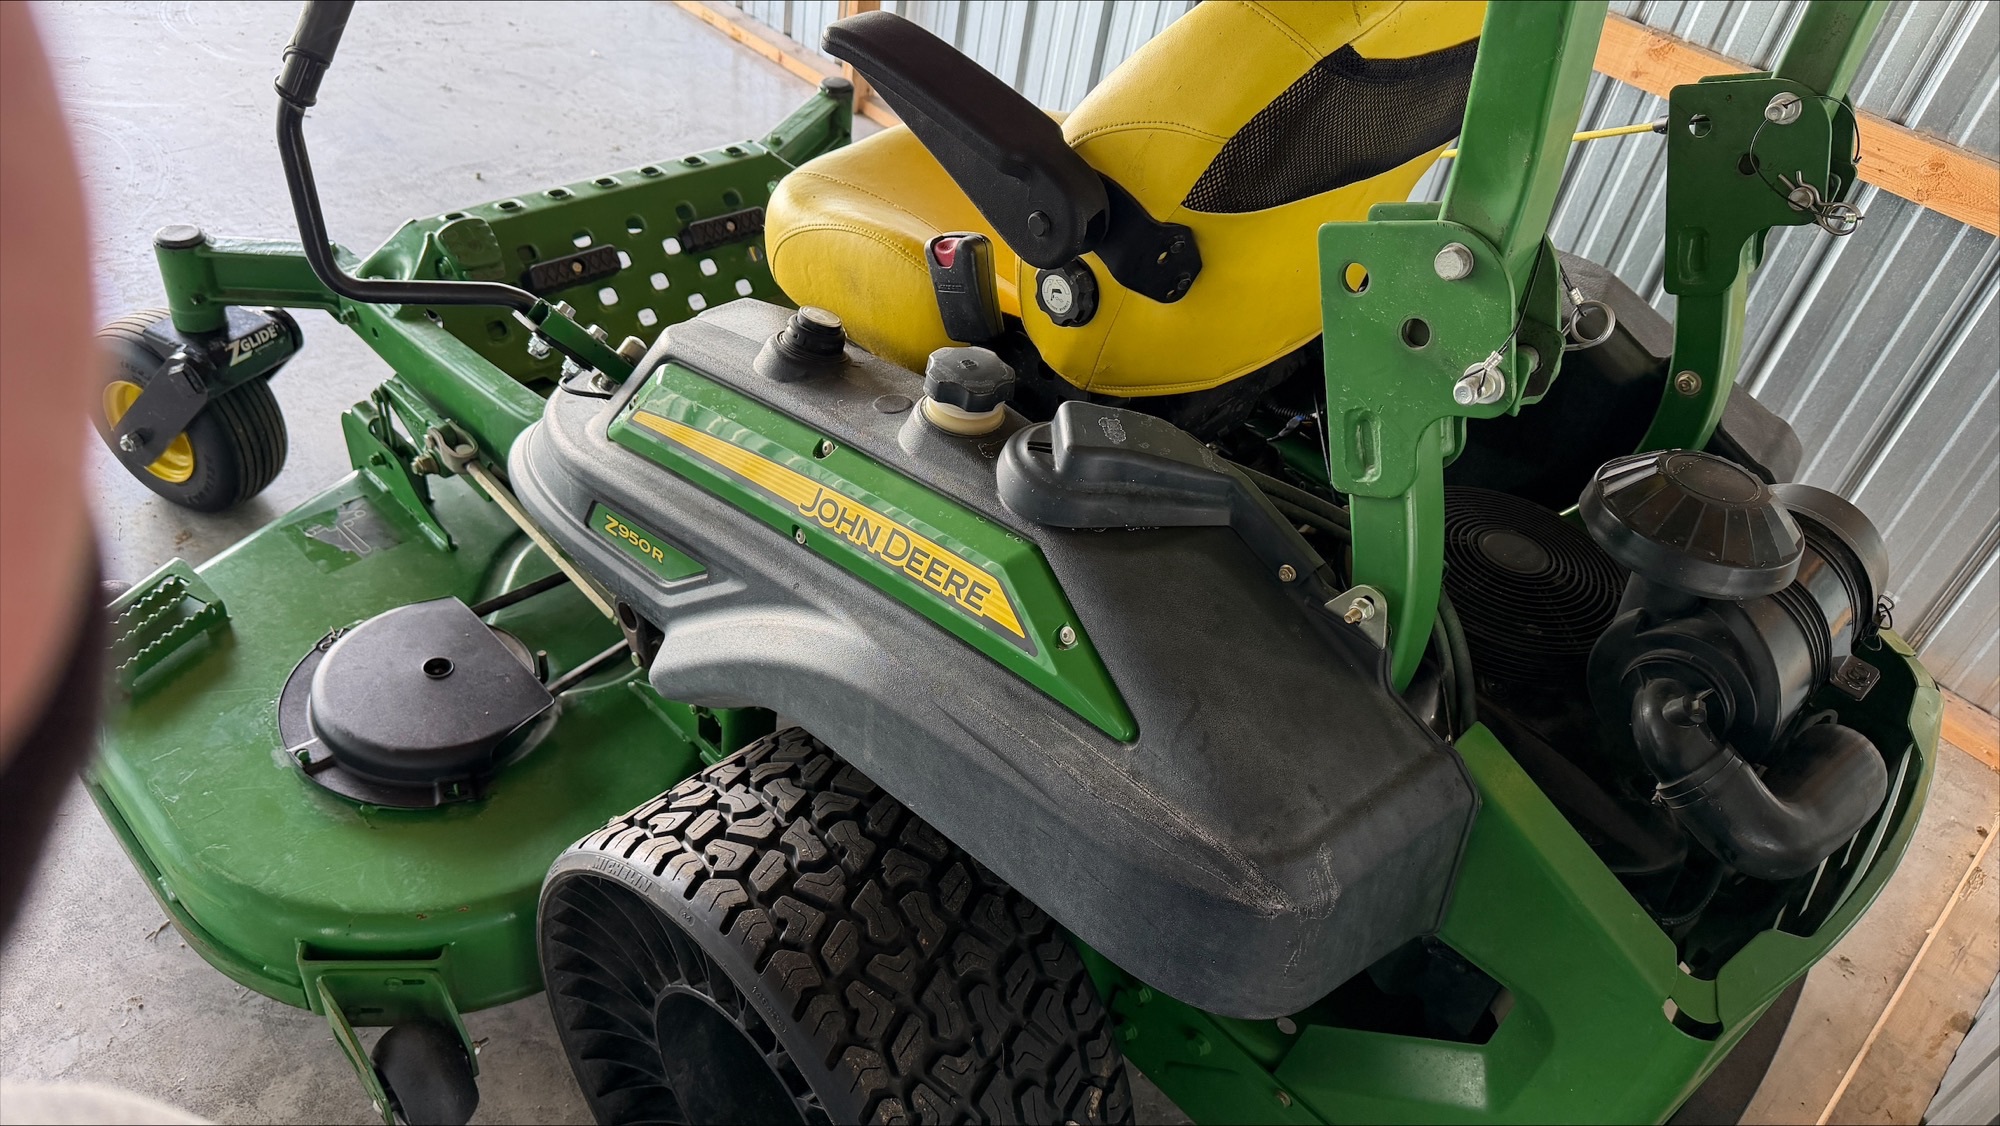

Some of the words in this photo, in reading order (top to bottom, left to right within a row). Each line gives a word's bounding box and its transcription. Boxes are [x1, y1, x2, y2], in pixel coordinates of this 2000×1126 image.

[225, 324, 278, 366] ZGLIDE
[800, 488, 881, 548] JOHN
[882, 527, 991, 612] DEERE
[592, 856, 652, 892] MICHELIN
